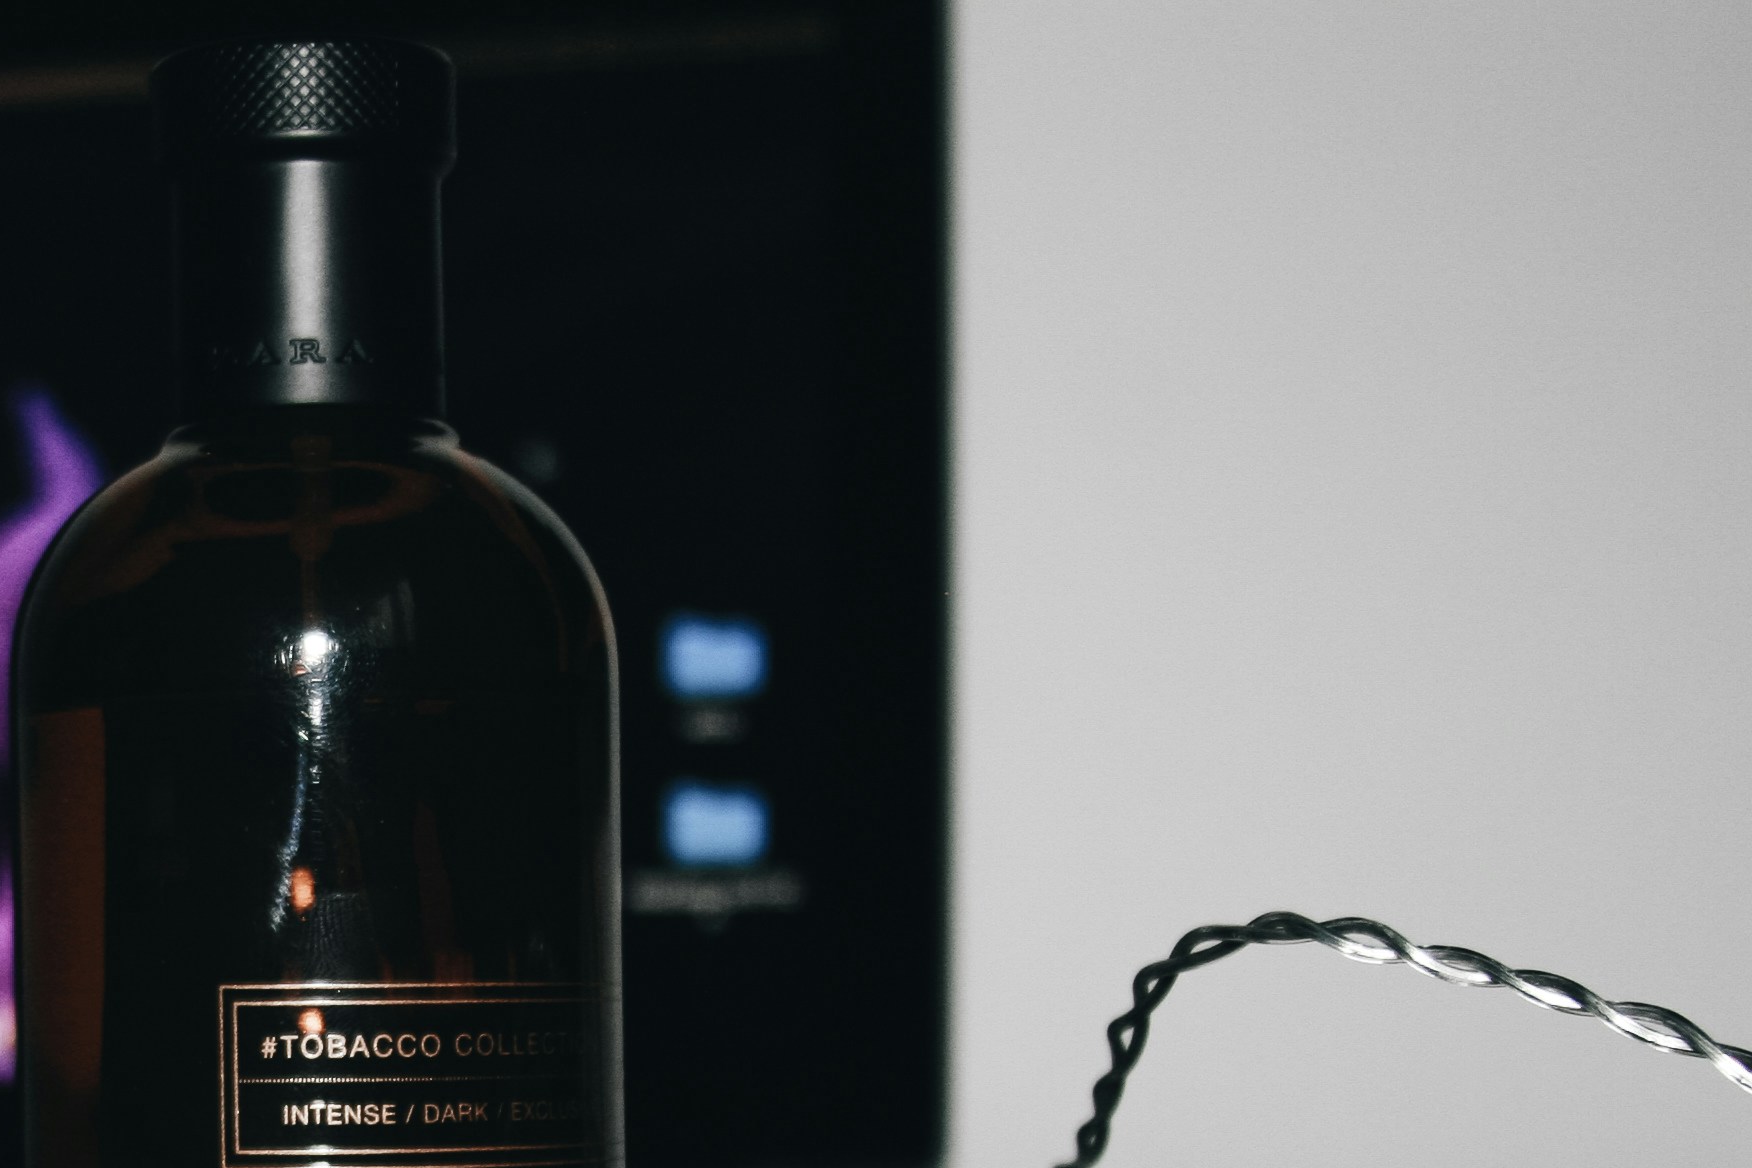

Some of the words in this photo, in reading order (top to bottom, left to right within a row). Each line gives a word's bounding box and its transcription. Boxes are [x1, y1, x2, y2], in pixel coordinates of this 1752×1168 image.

[261, 1032, 441, 1060] #TOBACCO
[282, 1102, 397, 1127] INTENSE
[405, 1103, 416, 1125] /
[424, 1101, 489, 1125] DARK
